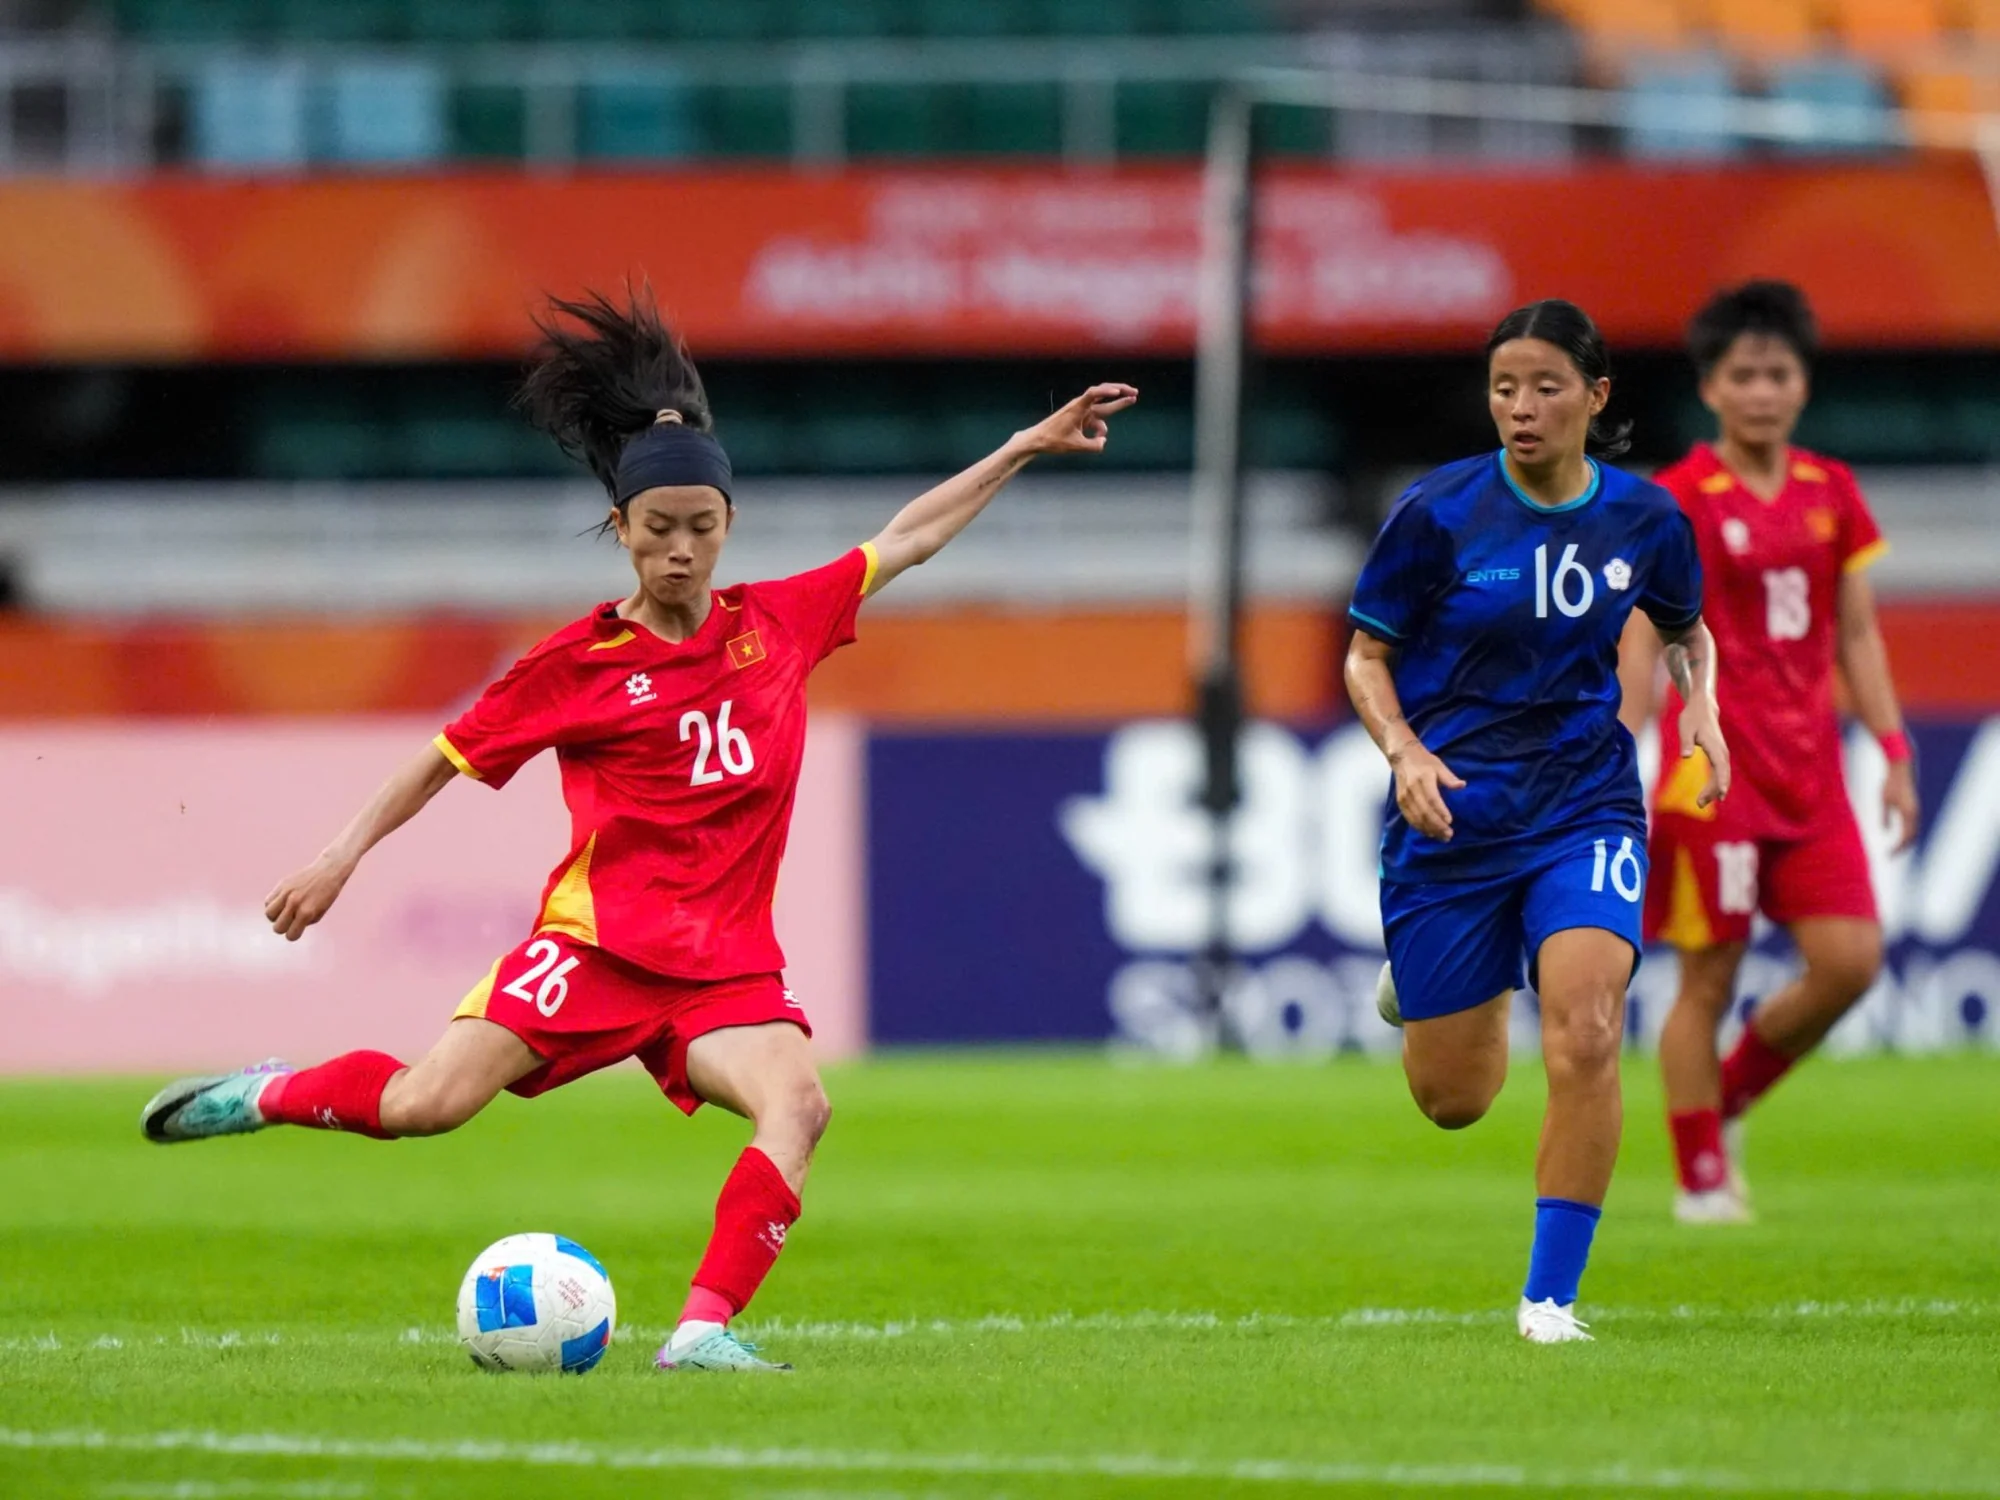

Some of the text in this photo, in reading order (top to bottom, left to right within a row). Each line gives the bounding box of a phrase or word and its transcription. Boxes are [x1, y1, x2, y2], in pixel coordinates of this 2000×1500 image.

[1466, 568, 1520, 583] ENTES
[1535, 544, 1594, 618] 16
[680, 700, 755, 786] 26
[1590, 836, 1641, 902] 16
[503, 940, 581, 1017] 26
